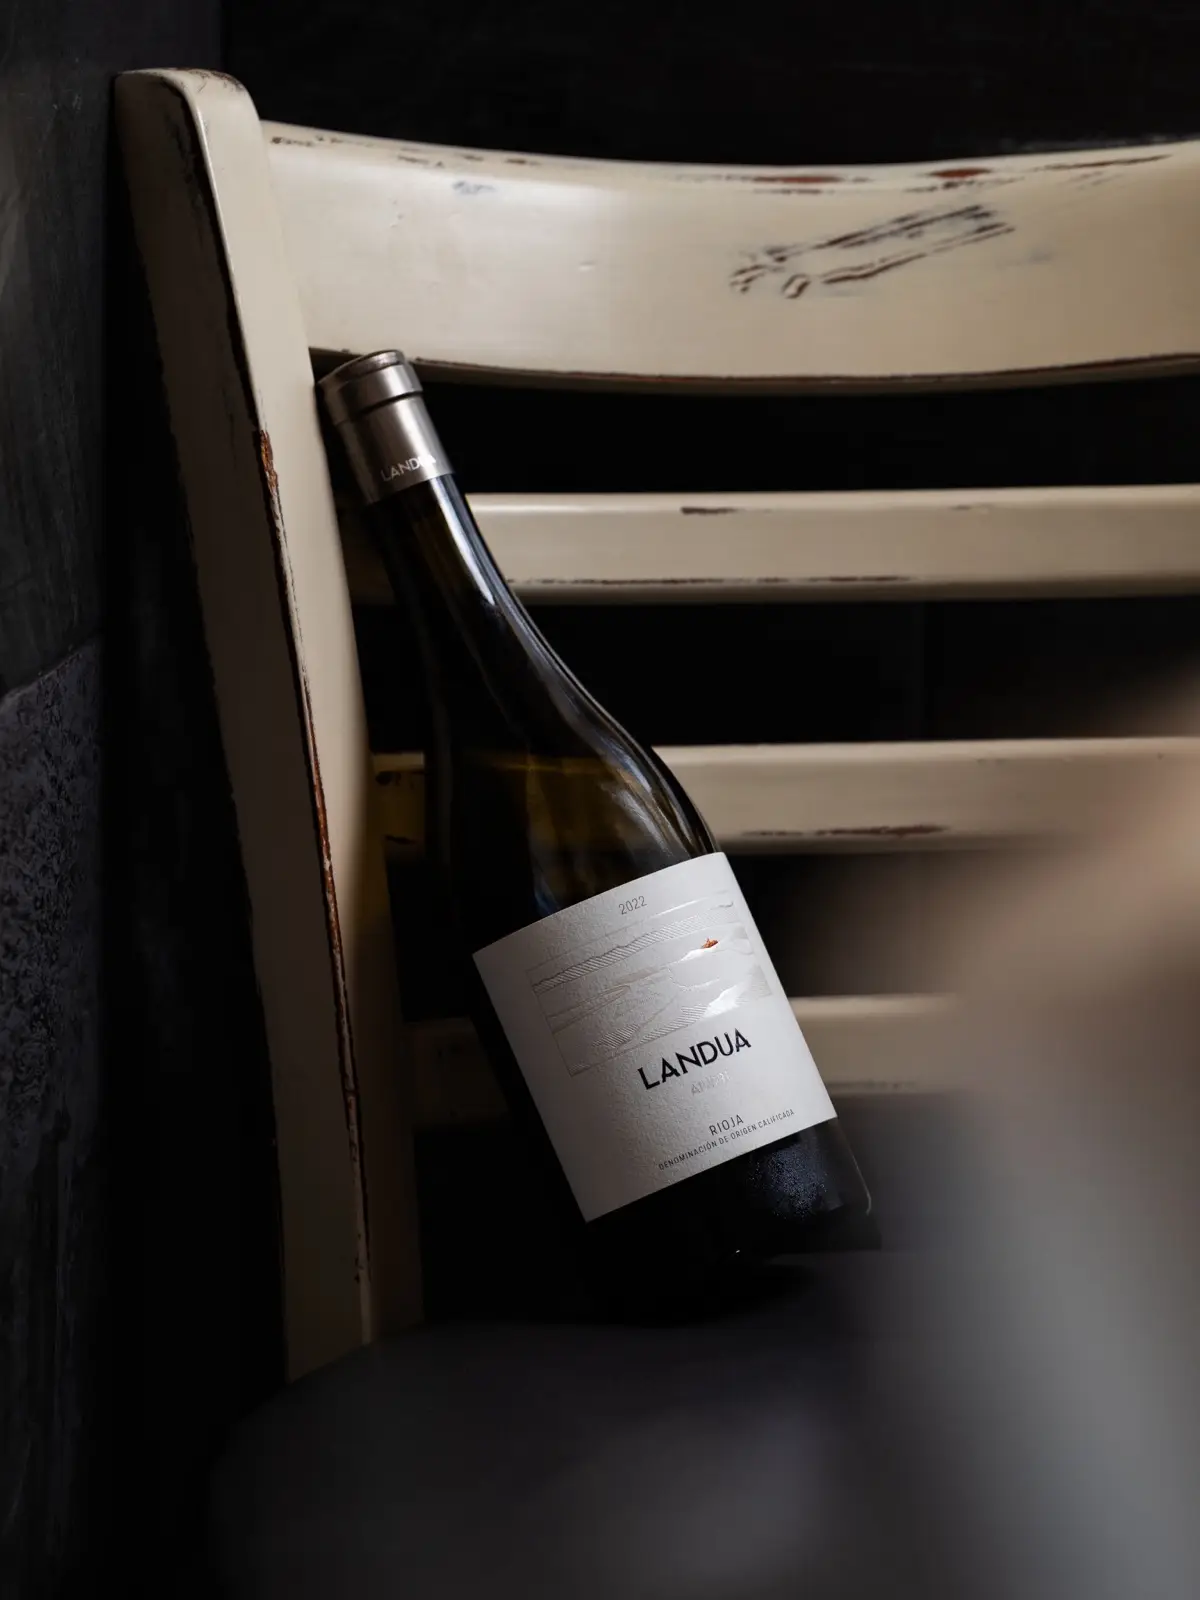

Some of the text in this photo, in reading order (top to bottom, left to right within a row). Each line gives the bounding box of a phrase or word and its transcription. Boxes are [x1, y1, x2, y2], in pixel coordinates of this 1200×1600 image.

[618, 895, 648, 915] 2022
[637, 1028, 752, 1090] LANDUA
[658, 1108, 795, 1171] DENOMINACIÓN DE ORIGEN CALIFICADA
[708, 1114, 744, 1136] RIOJA
